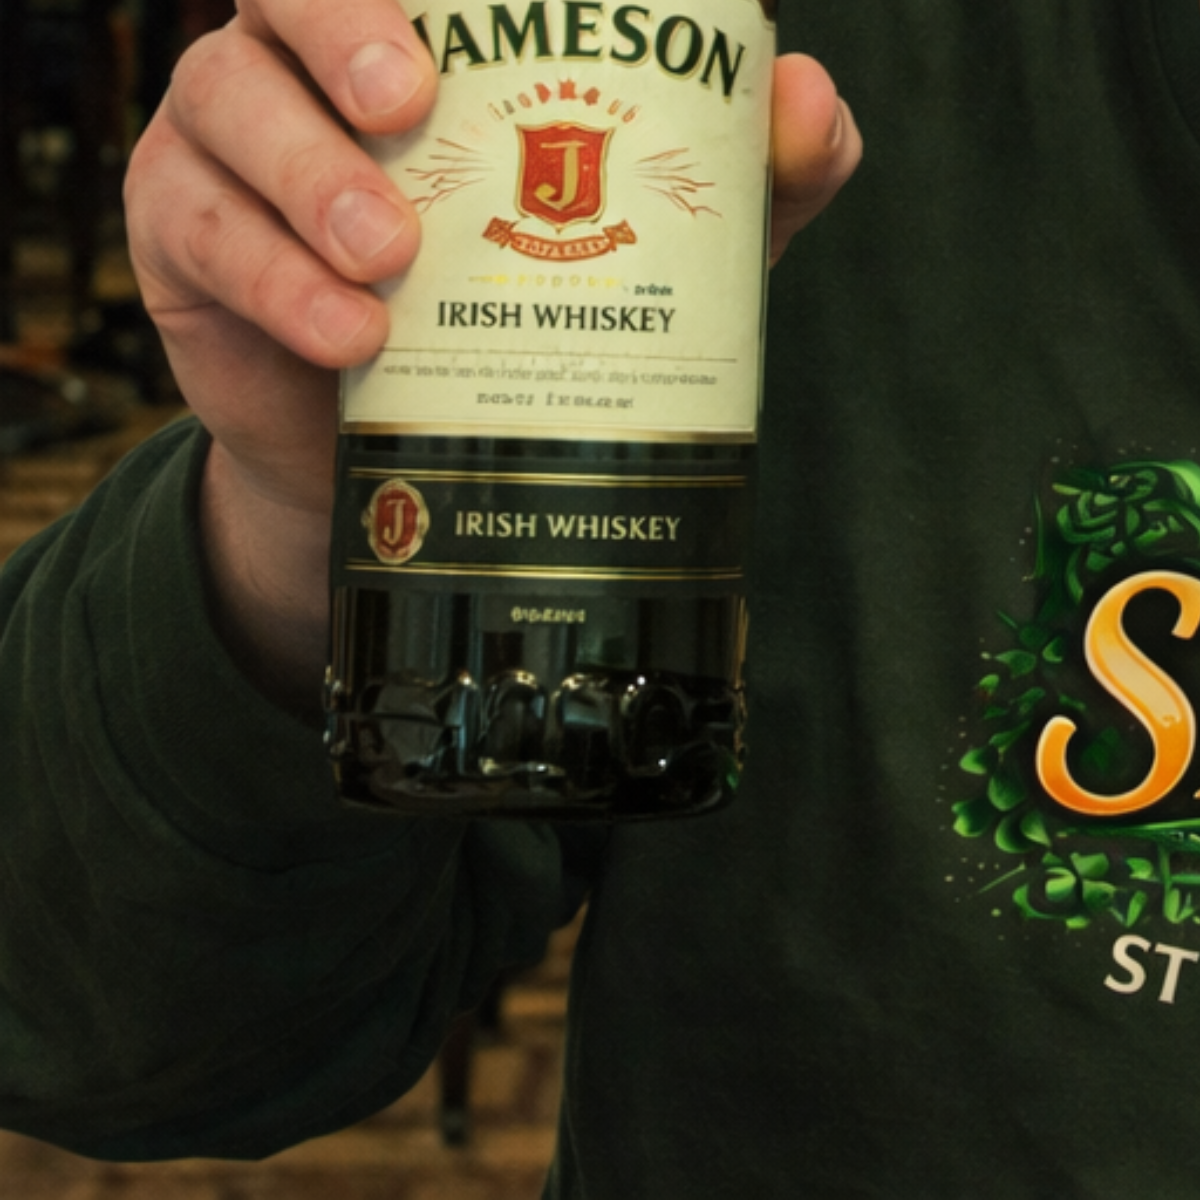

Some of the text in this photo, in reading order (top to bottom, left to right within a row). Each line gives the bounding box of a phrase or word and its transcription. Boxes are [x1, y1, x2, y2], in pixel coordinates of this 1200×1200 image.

[535, 140, 588, 210] J
[437, 301, 676, 333] IRISH WHISKEY
[382, 498, 406, 547] J
[455, 511, 681, 541] IRISH WHISKEY
[1104, 934, 1200, 1004] ST
